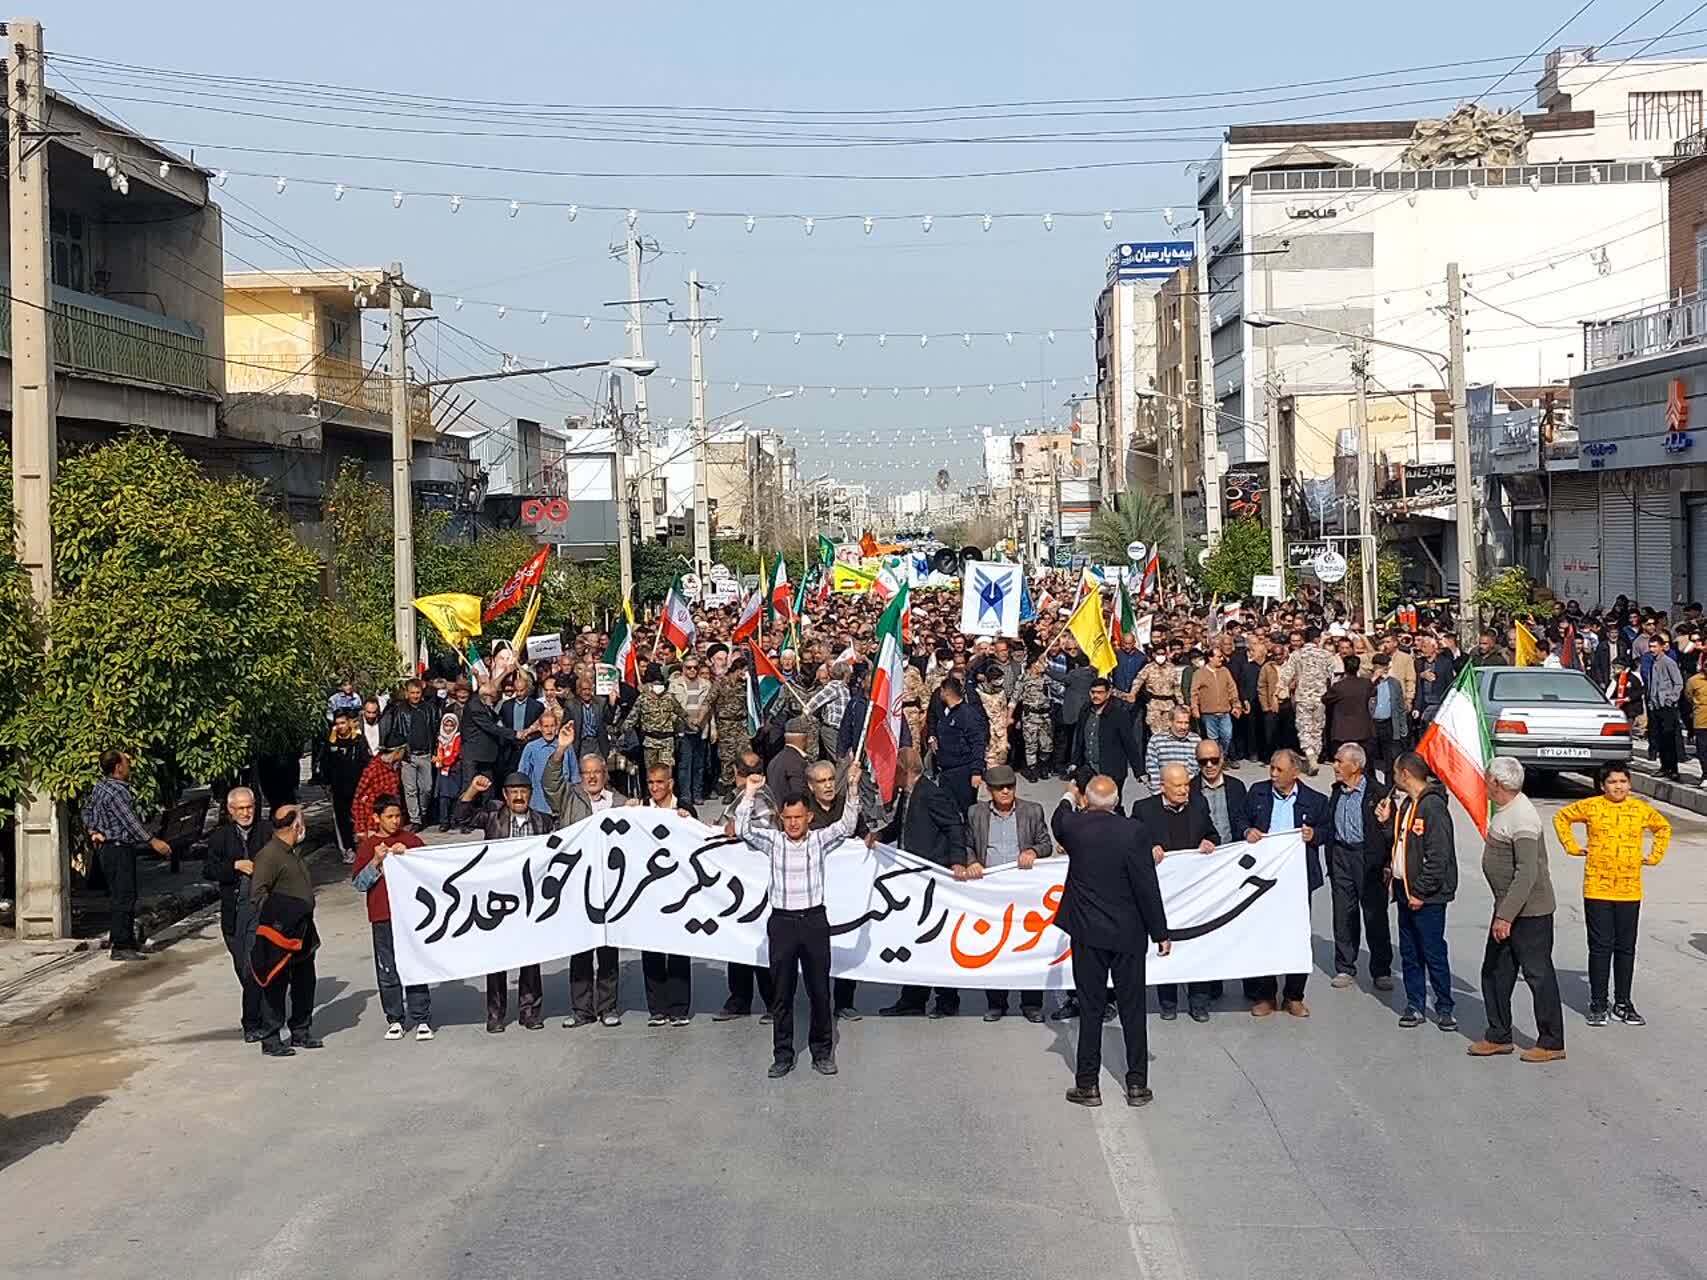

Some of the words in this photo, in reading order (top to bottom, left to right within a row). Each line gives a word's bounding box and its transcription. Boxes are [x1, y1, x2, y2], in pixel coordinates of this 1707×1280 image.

[1135, 245, 1171, 265] پارسیان
[1171, 247, 1193, 262] بیمه
[414, 845, 489, 945] کرد
[452, 834, 583, 938] خواهد
[584, 816, 679, 925] غرق
[660, 833, 747, 936] دیگر
[914, 877, 949, 944] را
